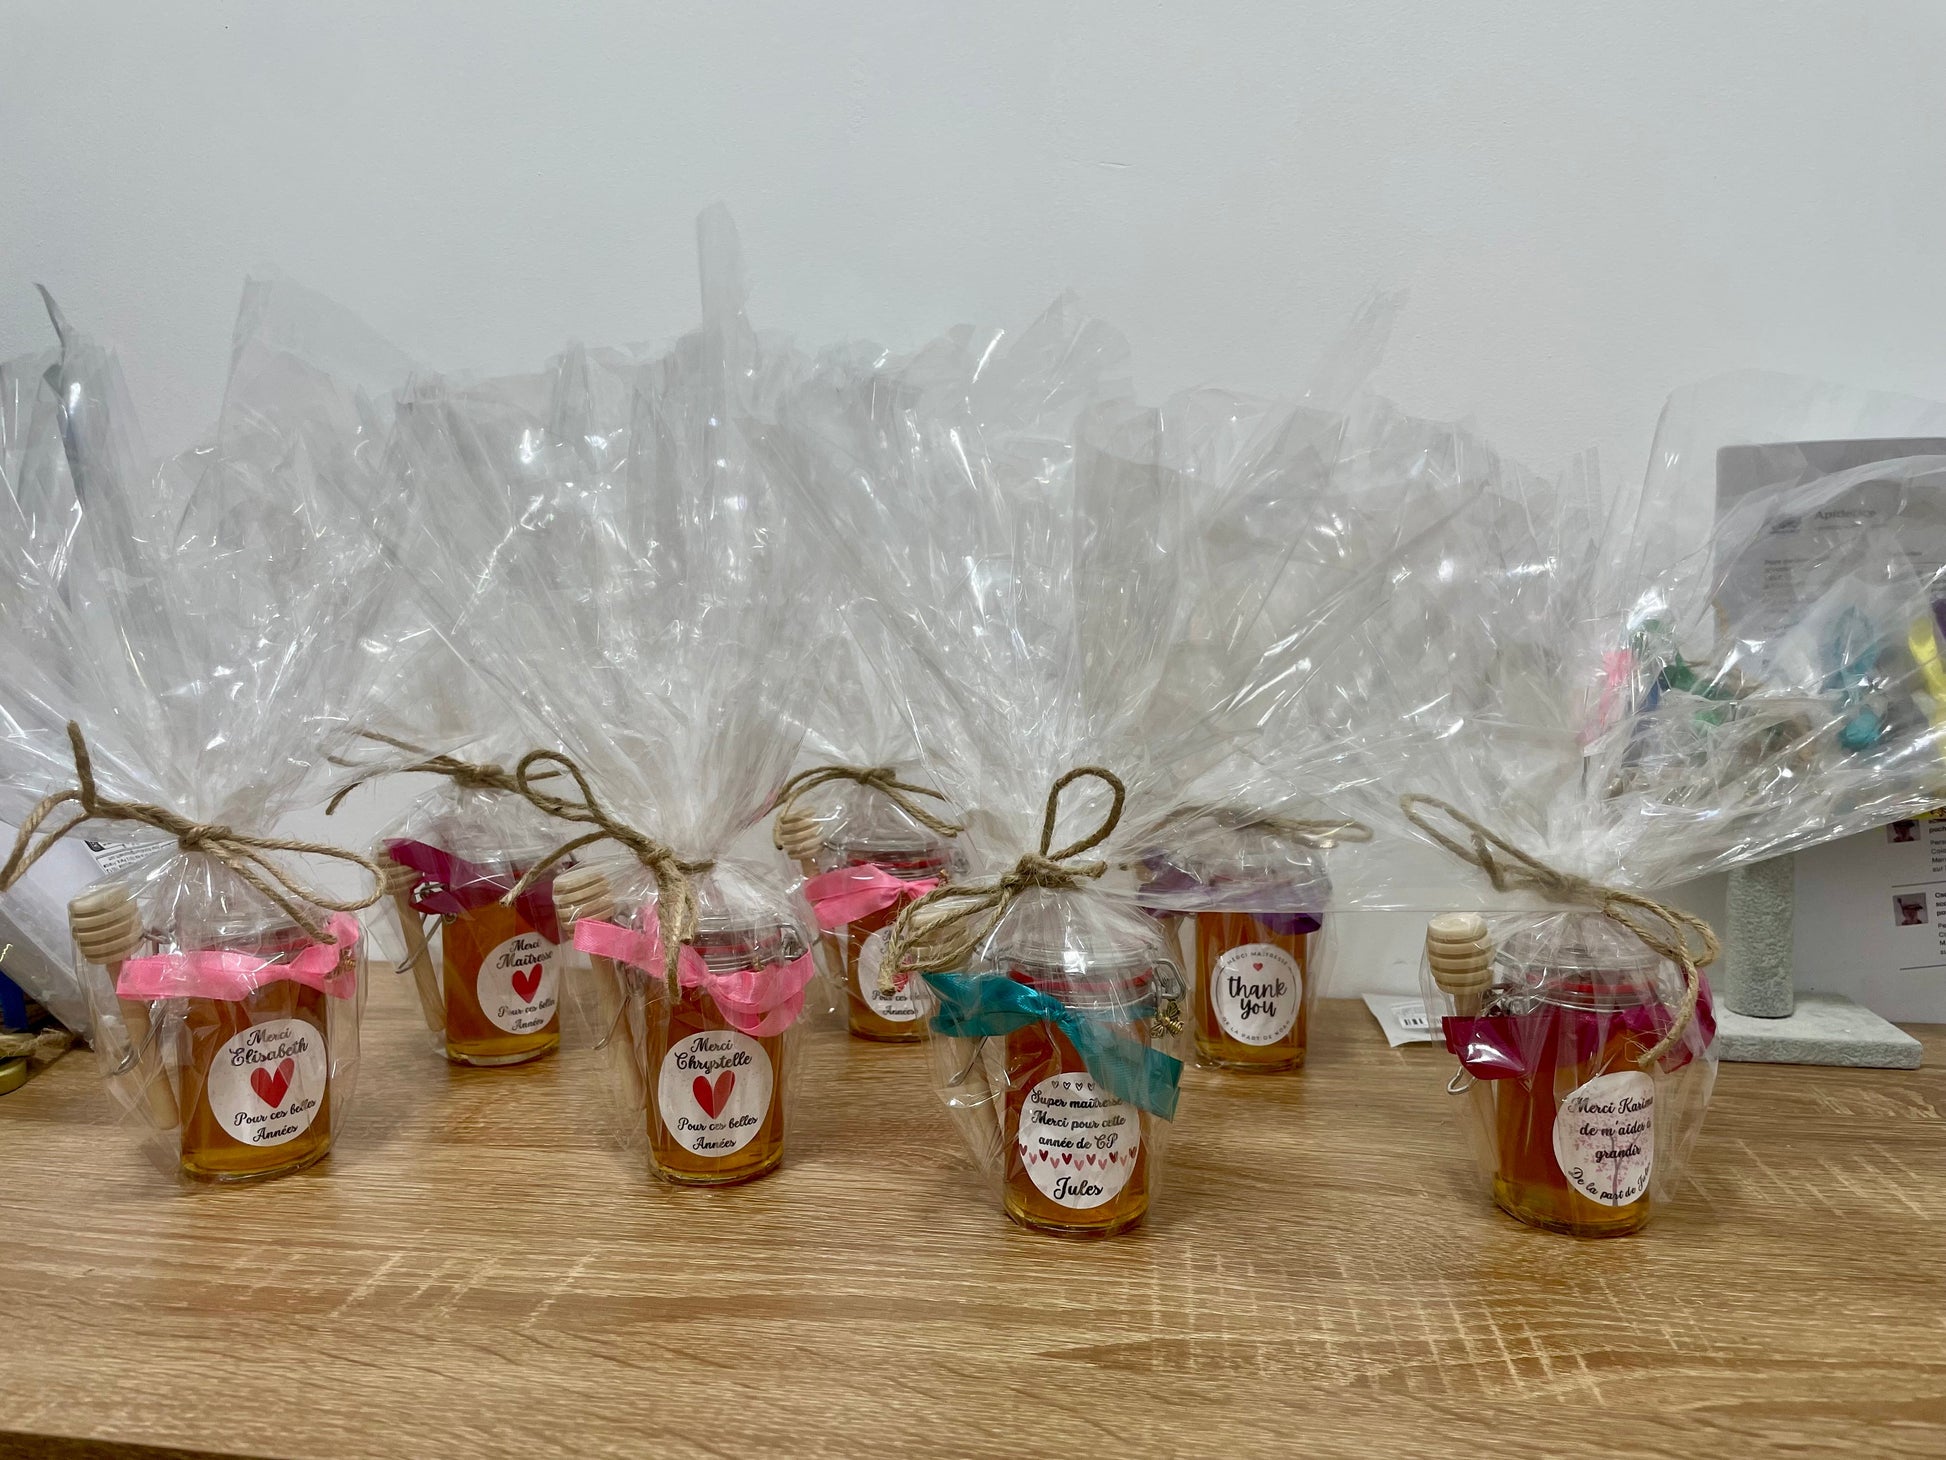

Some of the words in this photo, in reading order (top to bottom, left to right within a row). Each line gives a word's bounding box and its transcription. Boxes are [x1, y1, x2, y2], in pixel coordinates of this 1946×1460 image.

[510, 939, 541, 953] Merci
[1227, 952, 1248, 965] MERCI
[1227, 975, 1288, 999] thank
[1240, 998, 1277, 1020] you
[247, 1027, 292, 1046] Merci
[1230, 1026, 1240, 1035] LA
[1241, 1033, 1260, 1041] PART
[229, 1037, 309, 1067] Elisabeth
[690, 1037, 734, 1053] Merci
[674, 1050, 753, 1074] Chrystelle
[1030, 1088, 1068, 1108] Super
[1567, 1096, 1616, 1114] Merci
[234, 1111, 267, 1127] Pour
[270, 1110, 287, 1120] ces
[290, 1098, 316, 1115] belles
[1031, 1109, 1069, 1128] Merci
[1070, 1121, 1100, 1131] pour
[1101, 1115, 1126, 1128] cette
[677, 1117, 707, 1131] Pour
[709, 1122, 727, 1131] ces
[728, 1114, 758, 1129] belles
[1579, 1122, 1599, 1136] de
[1600, 1120, 1645, 1137] m'aider
[252, 1124, 299, 1142] Années
[1038, 1136, 1074, 1149] année
[1076, 1137, 1093, 1149] de
[1094, 1132, 1118, 1150] CP
[692, 1136, 737, 1151] Années
[1594, 1143, 1641, 1164] grandir
[1053, 1176, 1104, 1200] Jules
[1568, 1166, 1586, 1186] De
[1585, 1182, 1599, 1195] la
[1599, 1190, 1624, 1200] part
[1625, 1187, 1636, 1198] de
